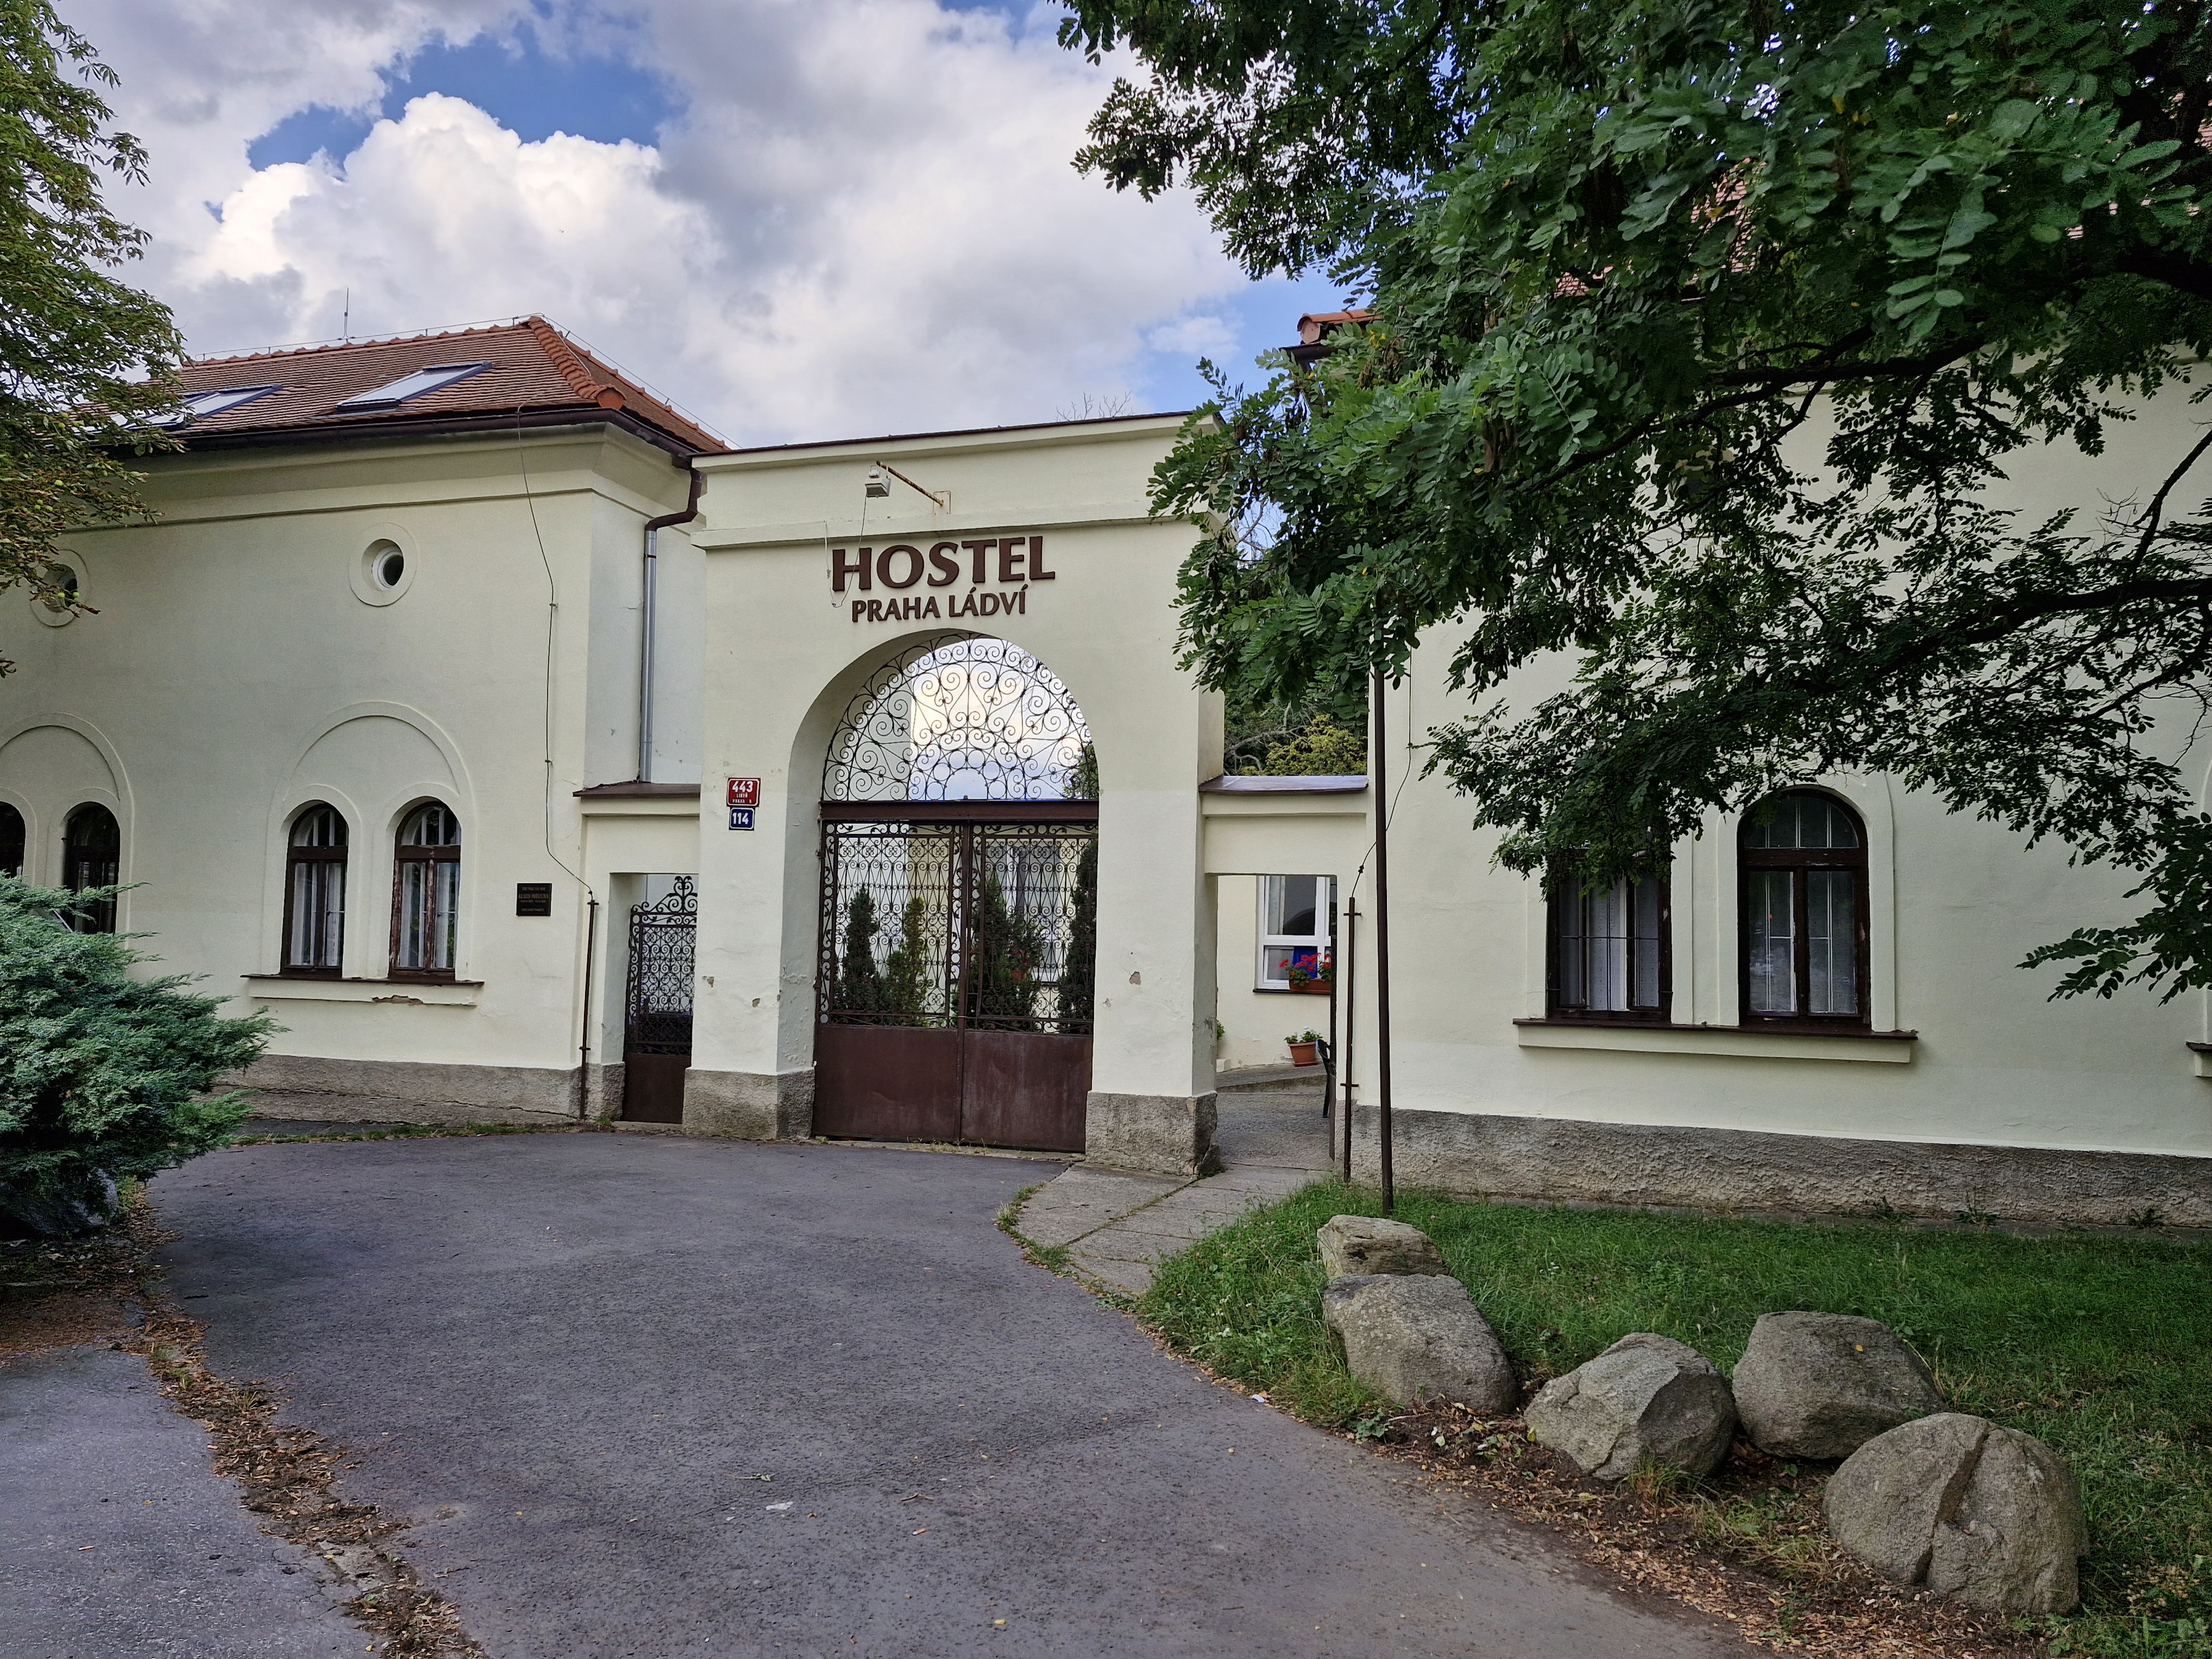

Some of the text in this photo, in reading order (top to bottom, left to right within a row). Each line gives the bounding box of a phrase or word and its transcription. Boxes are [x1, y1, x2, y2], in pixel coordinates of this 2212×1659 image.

[832, 536, 1055, 592] HOSTEL
[852, 584, 1028, 622] PRAHA LÁDVÍ
[732, 781, 753, 792] 443
[733, 812, 749, 825] 114
